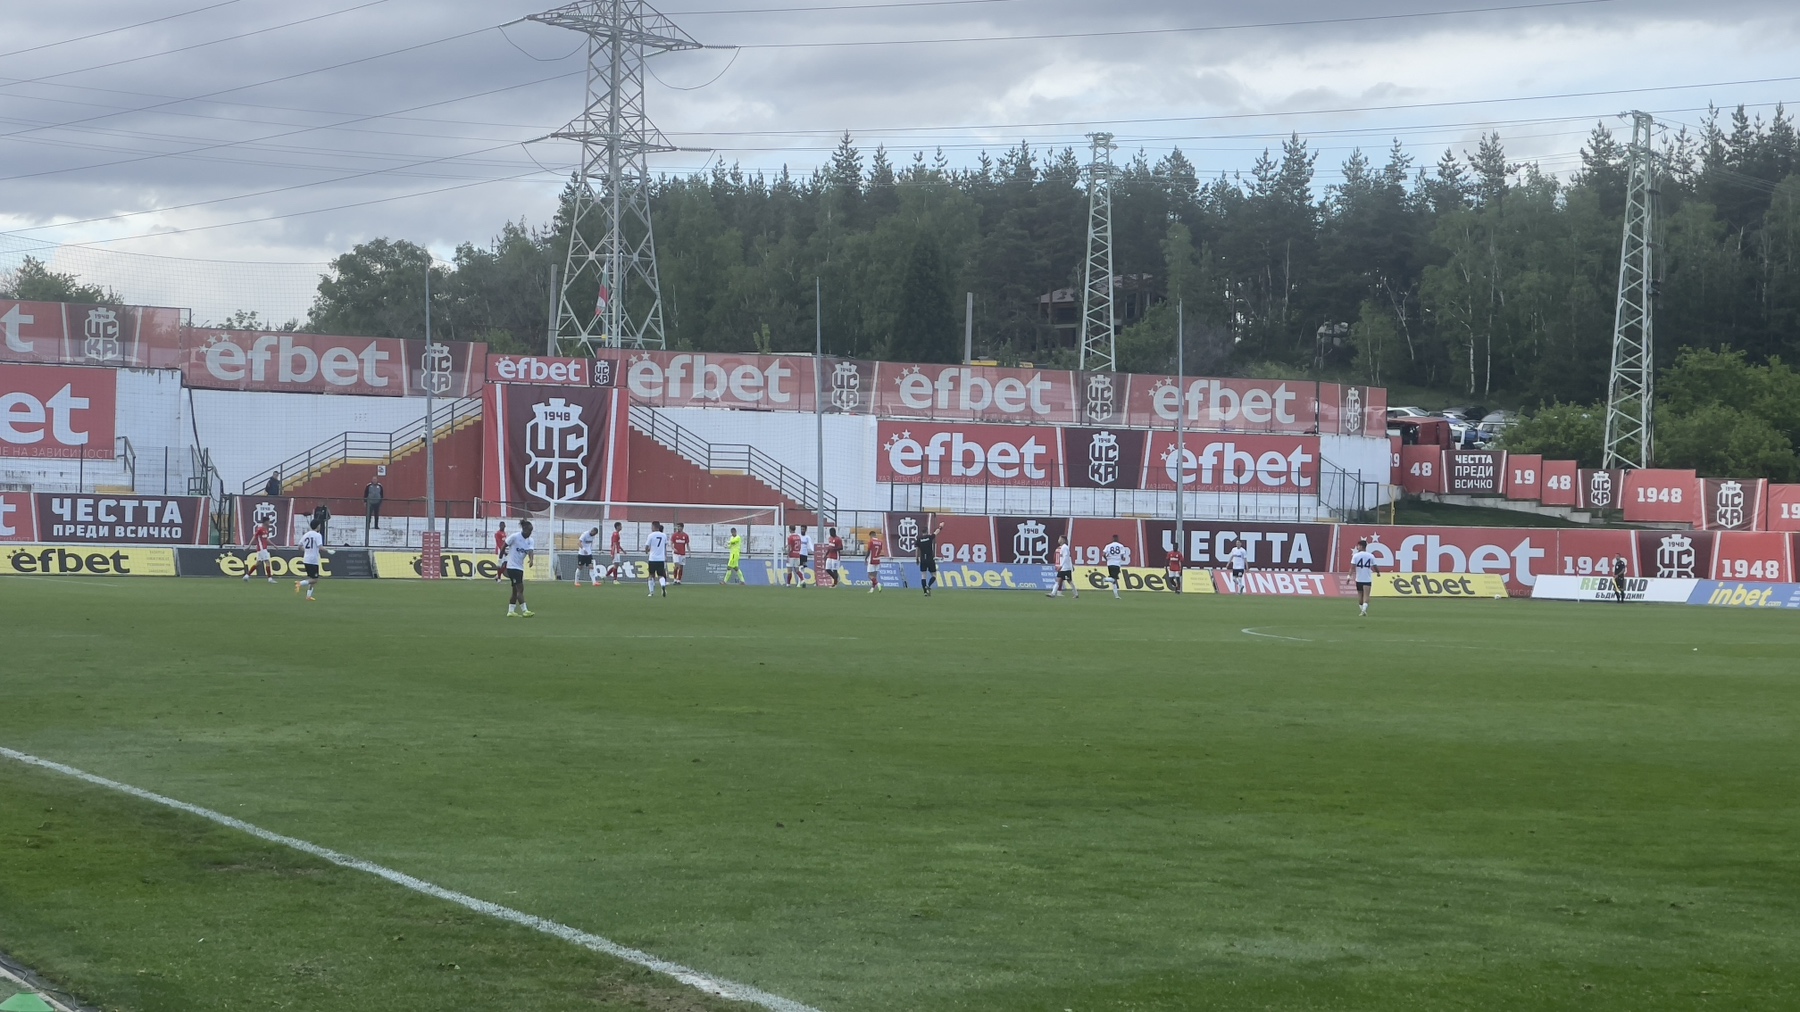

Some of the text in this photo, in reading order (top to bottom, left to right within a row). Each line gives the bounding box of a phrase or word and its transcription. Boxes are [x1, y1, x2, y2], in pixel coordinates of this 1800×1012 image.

[206, 335, 389, 387] efbet
[498, 357, 580, 381] efbet
[628, 354, 790, 402] efbet
[900, 368, 1051, 414] efbet
[1154, 380, 1296, 424] efbet
[543, 411, 571, 421] 1948
[889, 432, 1046, 479] efbet
[1166, 442, 1312, 486] efbet
[1455, 455, 1493, 464] ЧЕСТТА
[1410, 462, 1432, 477] 48
[1455, 466, 1493, 478] ПРЕДИ
[1514, 469, 1535, 484] 19
[1455, 479, 1493, 489] ВСИЧКО
[1547, 475, 1571, 490] 48
[1637, 487, 1682, 503] 1948
[51, 497, 183, 525] ЧЕСТТА
[53, 525, 182, 539] ПРЕДИ ВСИЧКО
[656, 537, 663, 547] 7
[305, 537, 314, 549] 21
[1109, 545, 1121, 554] 88
[1162, 529, 1313, 563] ЧЕСТТА
[11, 548, 130, 573] efbet
[940, 543, 987, 564] 948
[1074, 545, 1131, 566] 198
[1356, 558, 1371, 569] 44
[1366, 534, 1546, 587] efbet
[1722, 559, 1779, 579] 1948
[1220, 571, 1325, 595] WINBET
[1393, 575, 1475, 595] efbet
